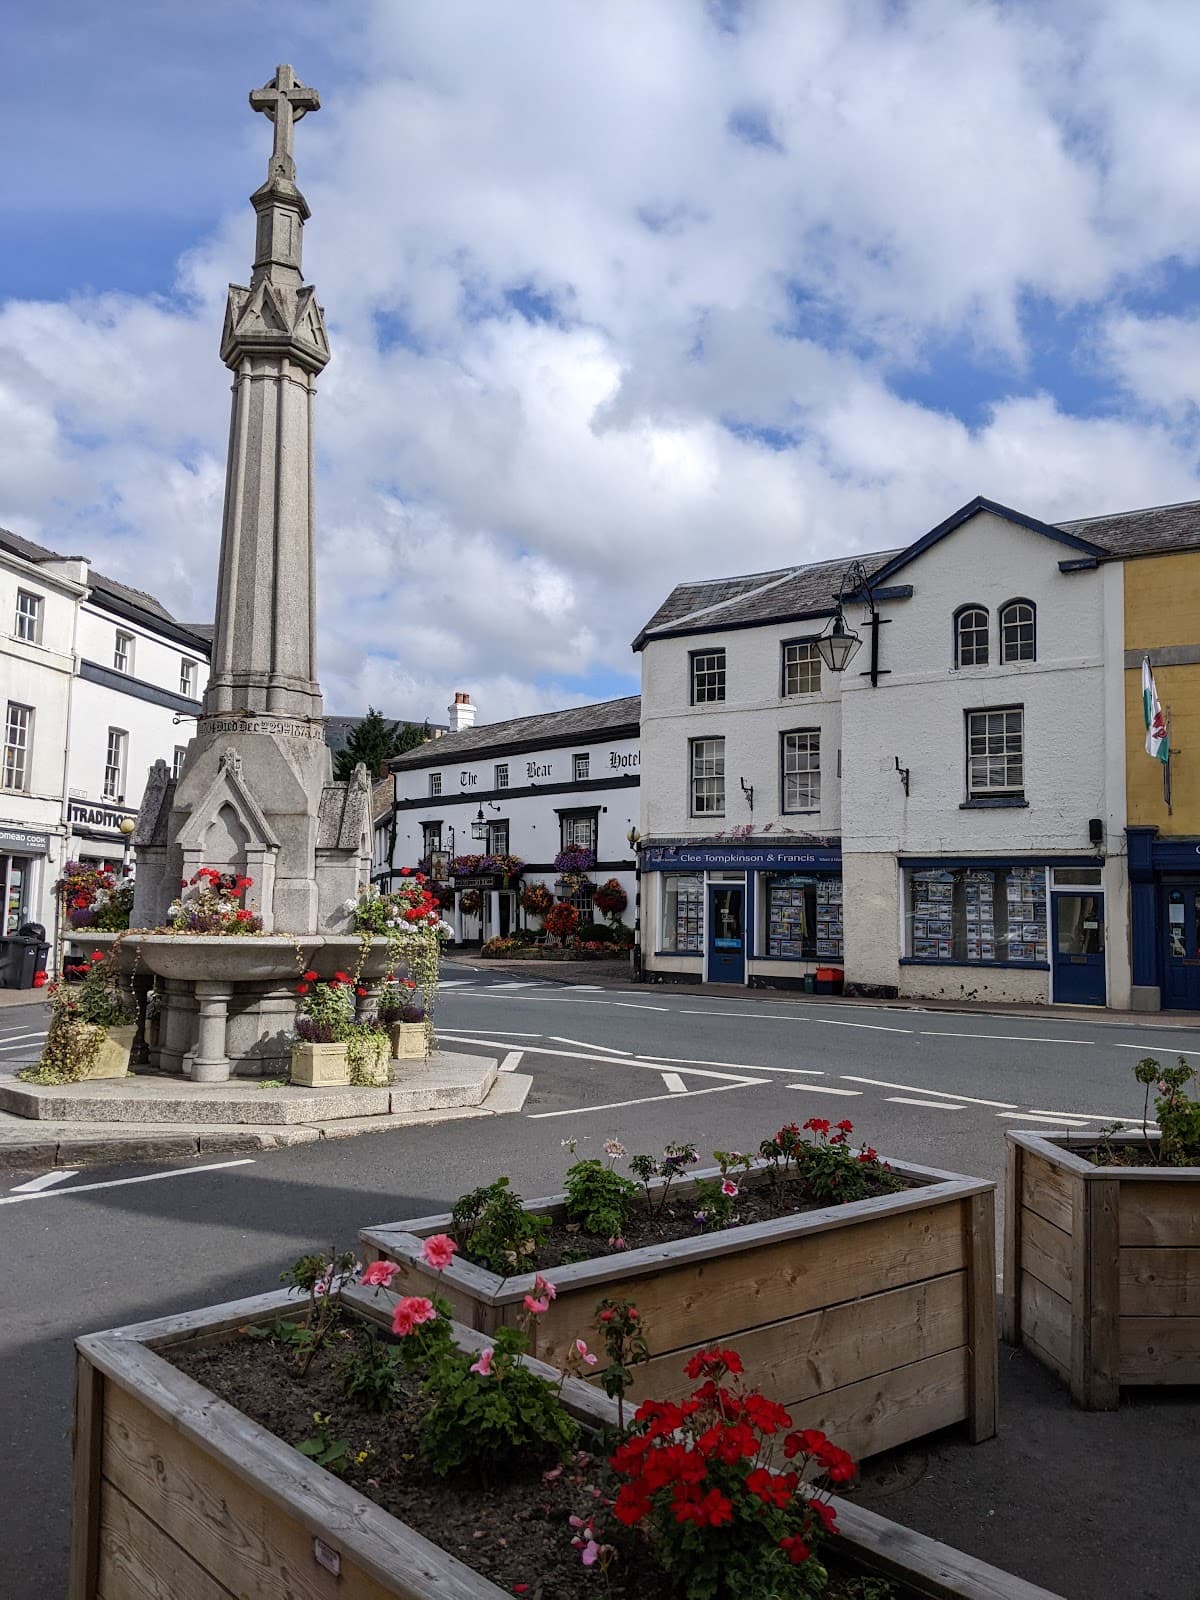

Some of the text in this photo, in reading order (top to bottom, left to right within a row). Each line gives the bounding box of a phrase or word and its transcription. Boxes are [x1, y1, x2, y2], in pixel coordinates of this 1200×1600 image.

[460, 771, 478, 787] The
[526, 762, 553, 779] Bear
[680, 854, 701, 862] Clee
[704, 854, 764, 864] Tompkinson
[766, 854, 776, 862] &
[777, 853, 815, 862] Francis
